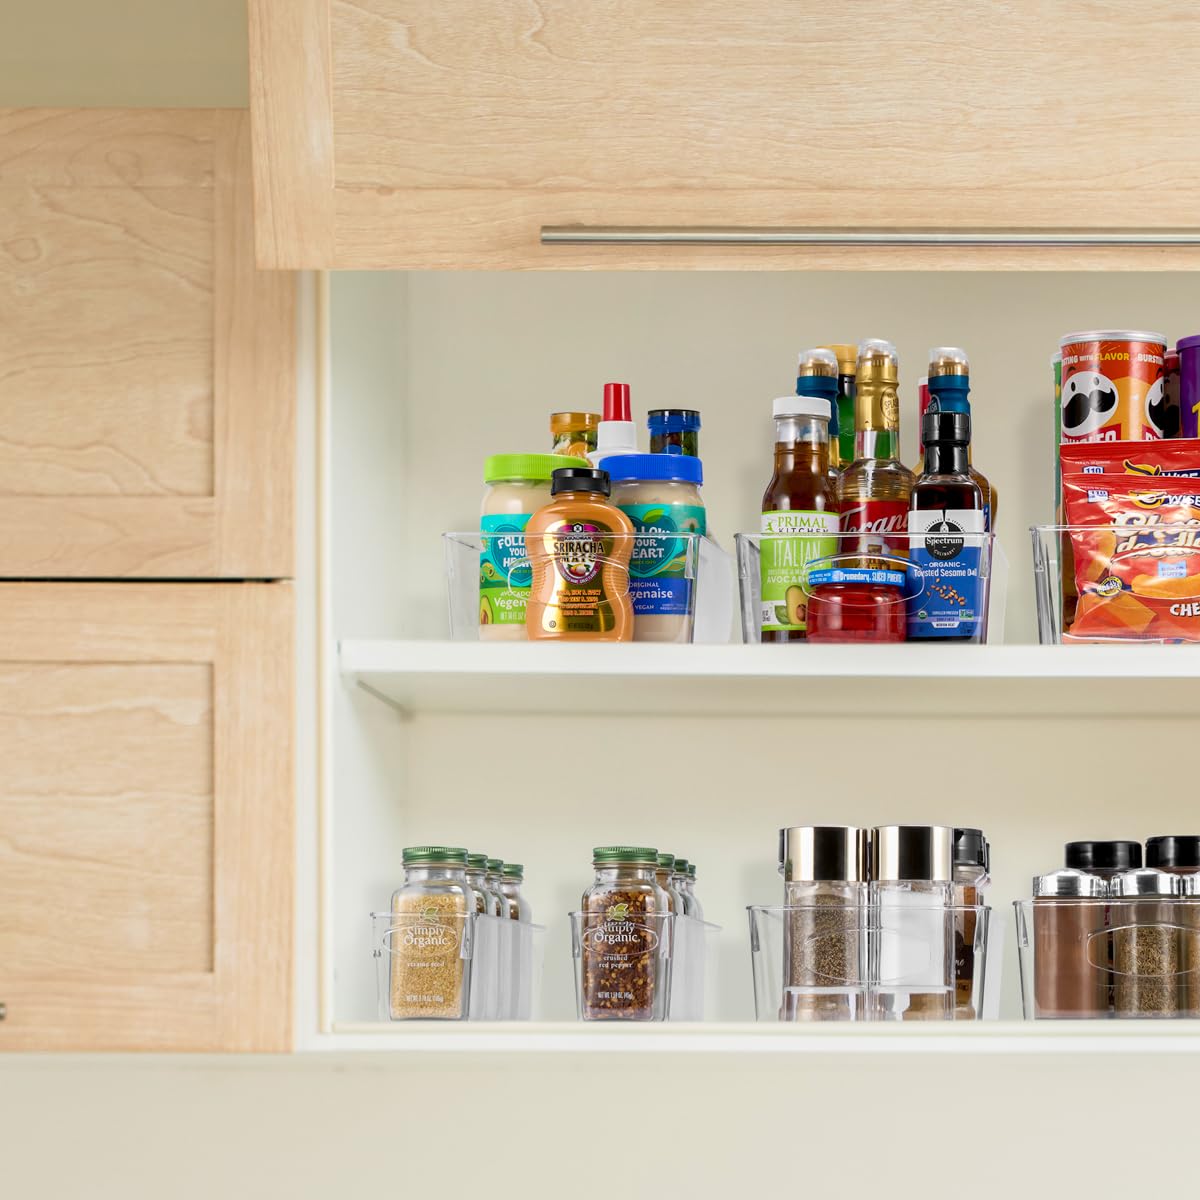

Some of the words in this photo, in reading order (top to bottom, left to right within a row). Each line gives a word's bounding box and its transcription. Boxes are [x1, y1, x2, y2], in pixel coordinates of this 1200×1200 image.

[1093, 353, 1129, 361] FLAVOR
[777, 516, 828, 528] PRIMAL
[926, 537, 963, 546] Spectrum
[553, 541, 604, 553] SRIRACHA
[940, 568, 966, 577] Sesame
